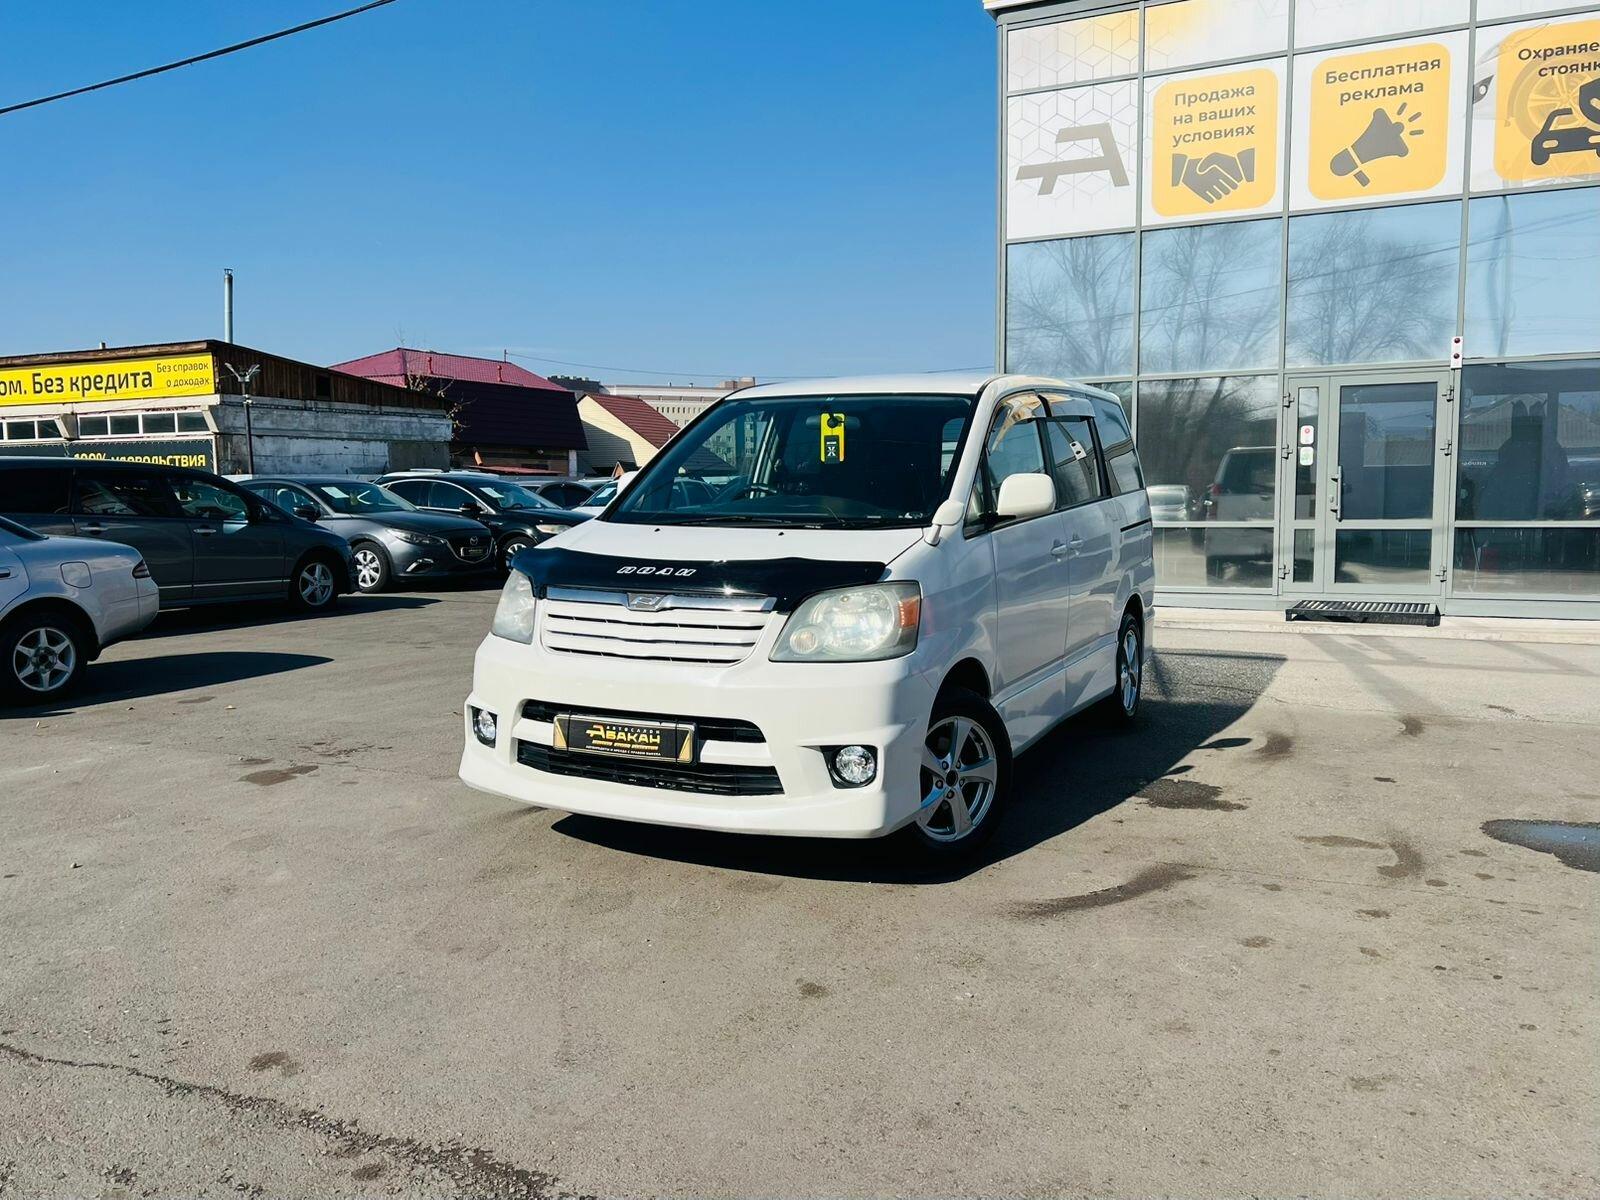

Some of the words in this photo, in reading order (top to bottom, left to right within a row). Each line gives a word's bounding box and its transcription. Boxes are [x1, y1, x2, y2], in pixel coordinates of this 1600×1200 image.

[1518, 41, 1600, 61] Охраняе
[1325, 58, 1441, 85] Бесплатная
[1174, 85, 1255, 107] Продажа
[1339, 82, 1424, 106] реклама
[1173, 113, 1193, 126] на
[1198, 105, 1256, 122] ваших
[1172, 125, 1255, 148] условиях
[156, 363, 172, 373] Без
[173, 362, 209, 373] справок
[32, 373, 65, 394] Без
[70, 370, 153, 397] кредита
[166, 380, 172, 388] о
[173, 377, 210, 388] доходах
